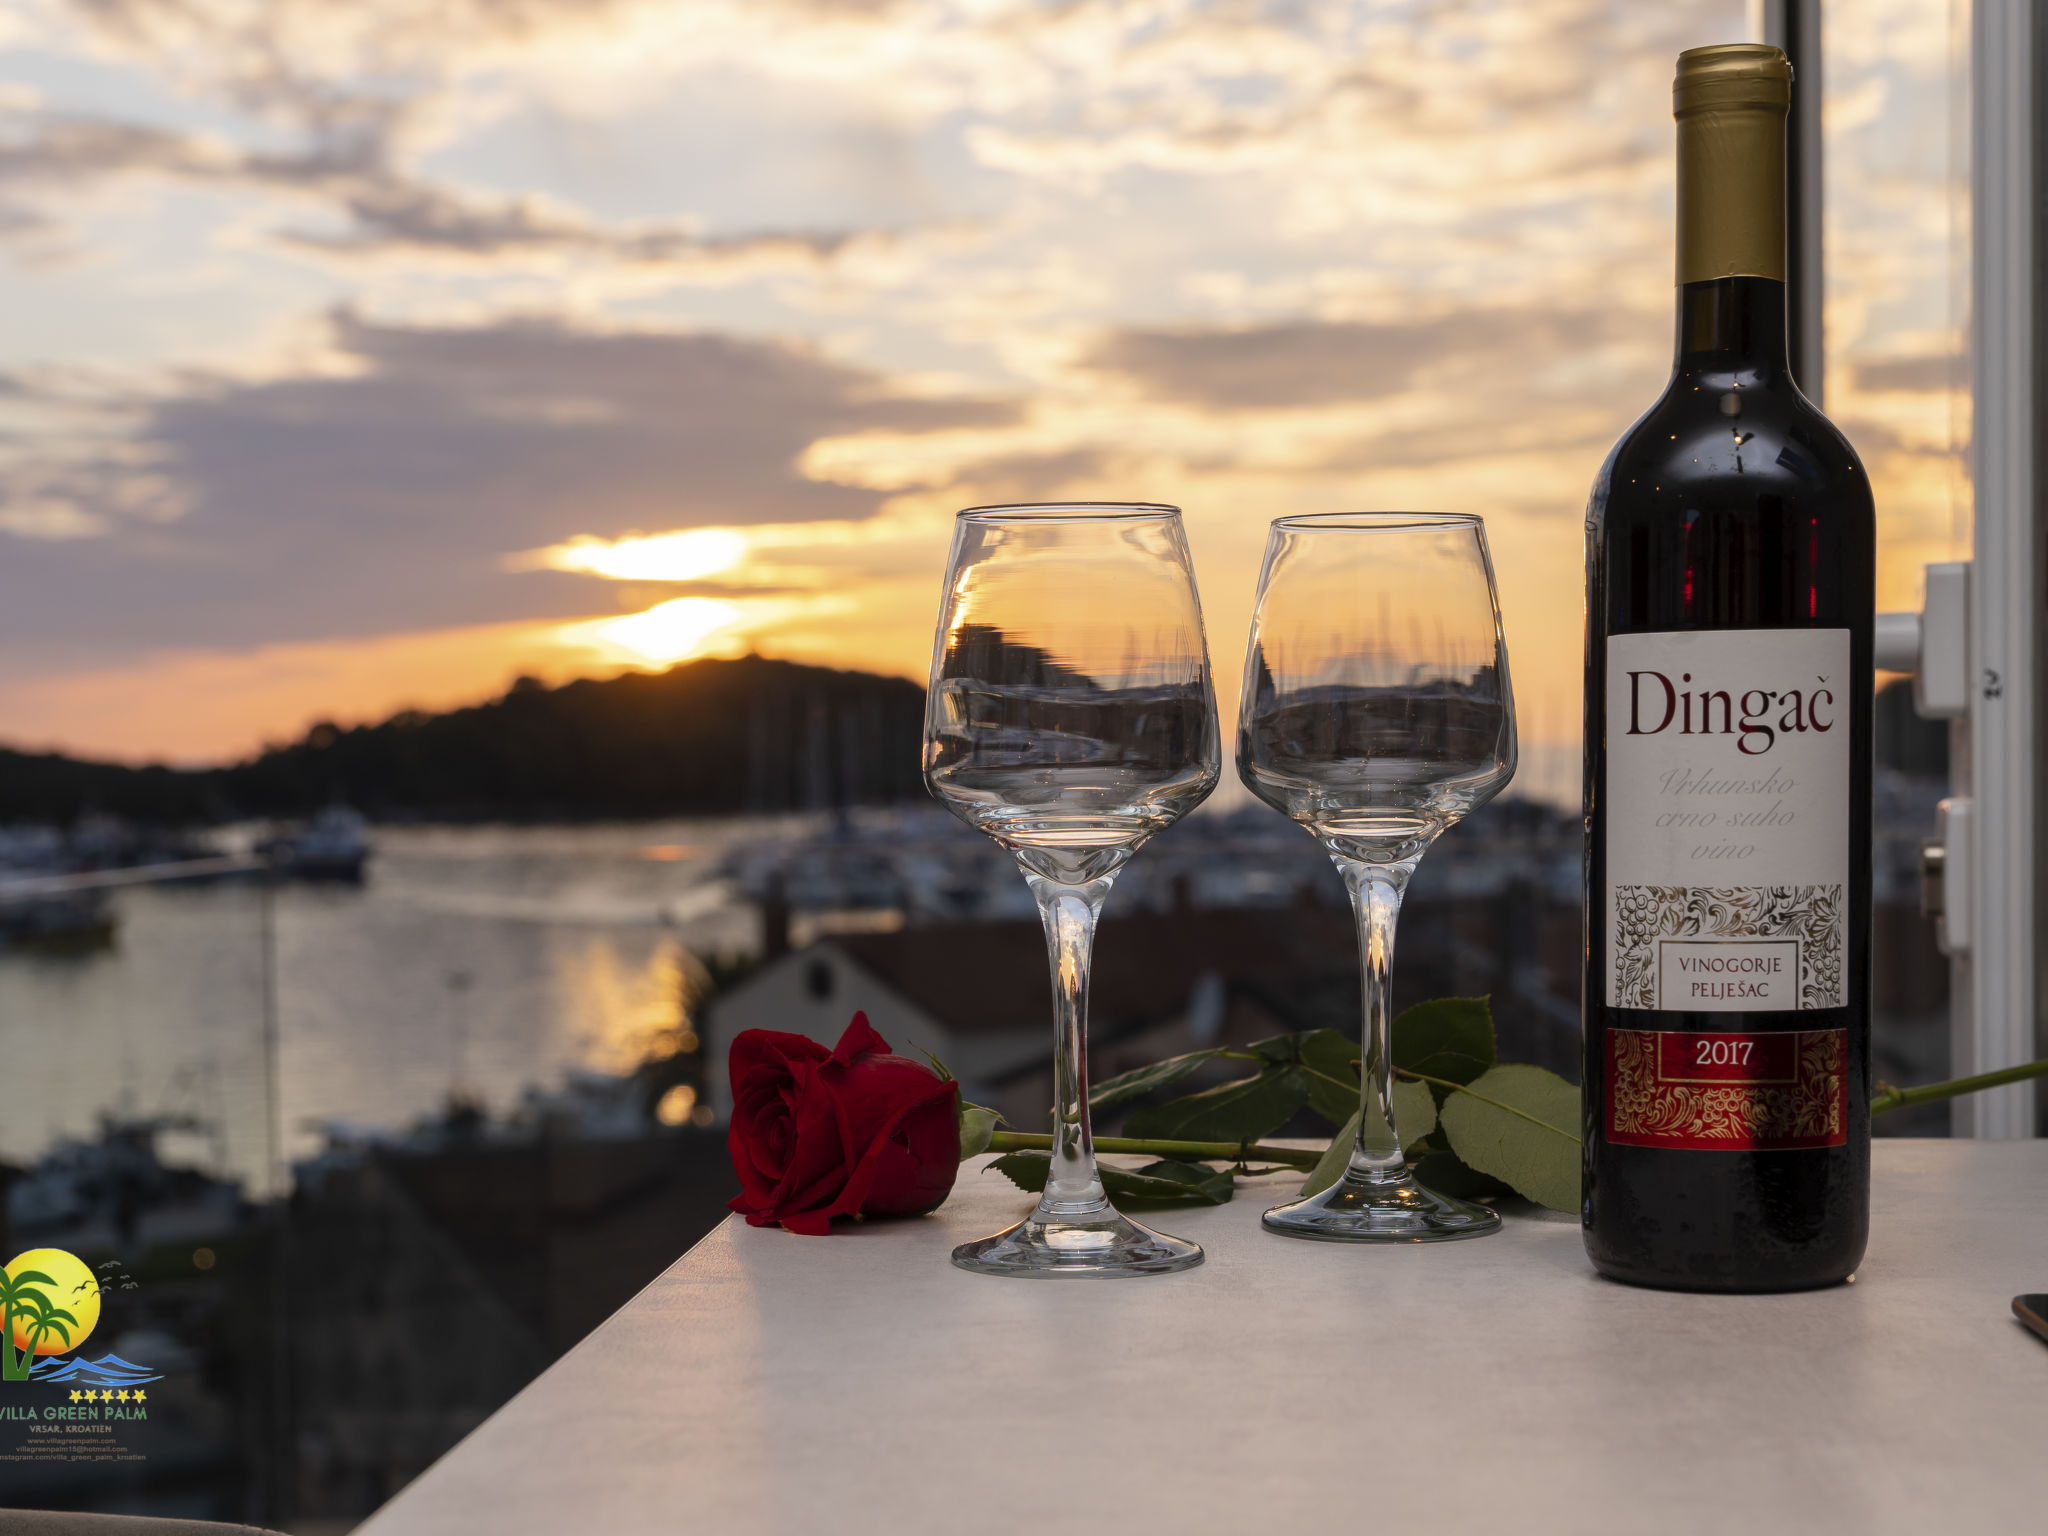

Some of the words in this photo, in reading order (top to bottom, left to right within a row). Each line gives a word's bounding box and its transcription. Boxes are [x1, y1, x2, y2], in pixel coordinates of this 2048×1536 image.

[1625, 671, 1834, 755] Dingač
[1658, 767, 1799, 795] Vrhunsko
[1655, 809, 1717, 828] crno
[1726, 799, 1796, 827] suho
[1690, 838, 1756, 860] vino
[1679, 957, 1782, 975] VINOGORJE
[1691, 980, 1769, 1000] PELJEŠAC
[1696, 1040, 1754, 1066] 2017
